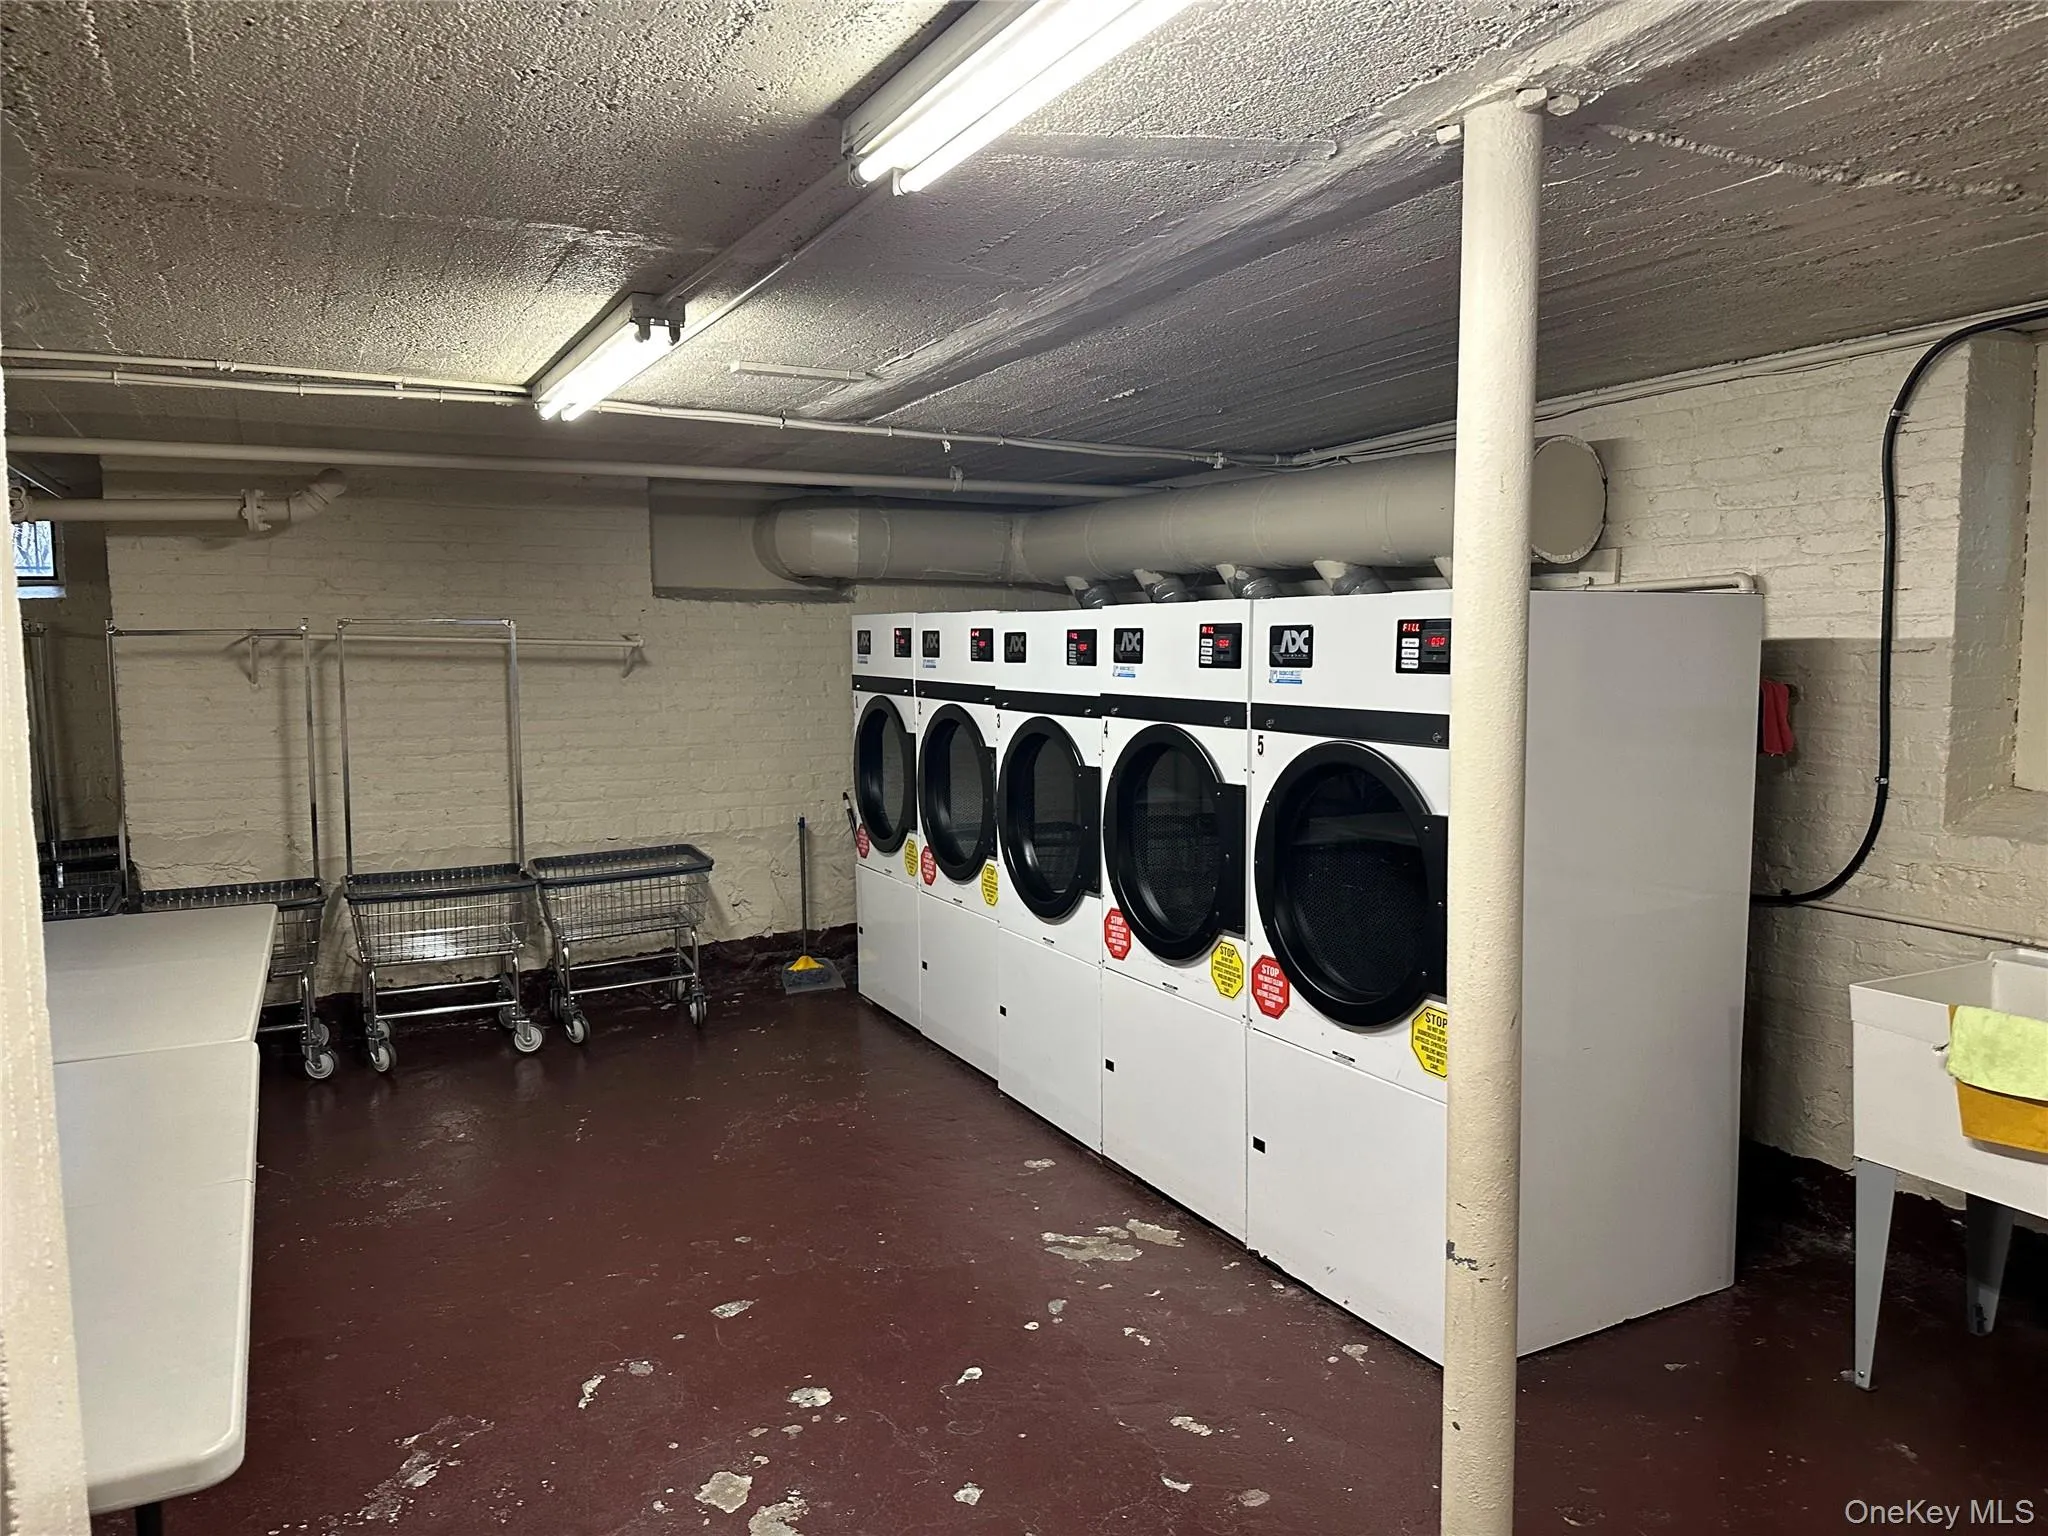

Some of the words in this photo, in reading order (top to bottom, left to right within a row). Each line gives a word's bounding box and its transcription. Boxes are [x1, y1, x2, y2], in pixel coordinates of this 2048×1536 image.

[1402, 623, 1420, 632] FILL
[1120, 631, 1141, 652] ADC
[1280, 630, 1309, 653] ADC
[918, 700, 922, 715] 2
[996, 713, 1001, 729] 3
[1103, 720, 1109, 738] 4
[1257, 735, 1264, 756] 5
[1220, 945, 1235, 958] STOP
[1261, 963, 1280, 978] STOP
[1425, 1012, 1448, 1029] STOP
